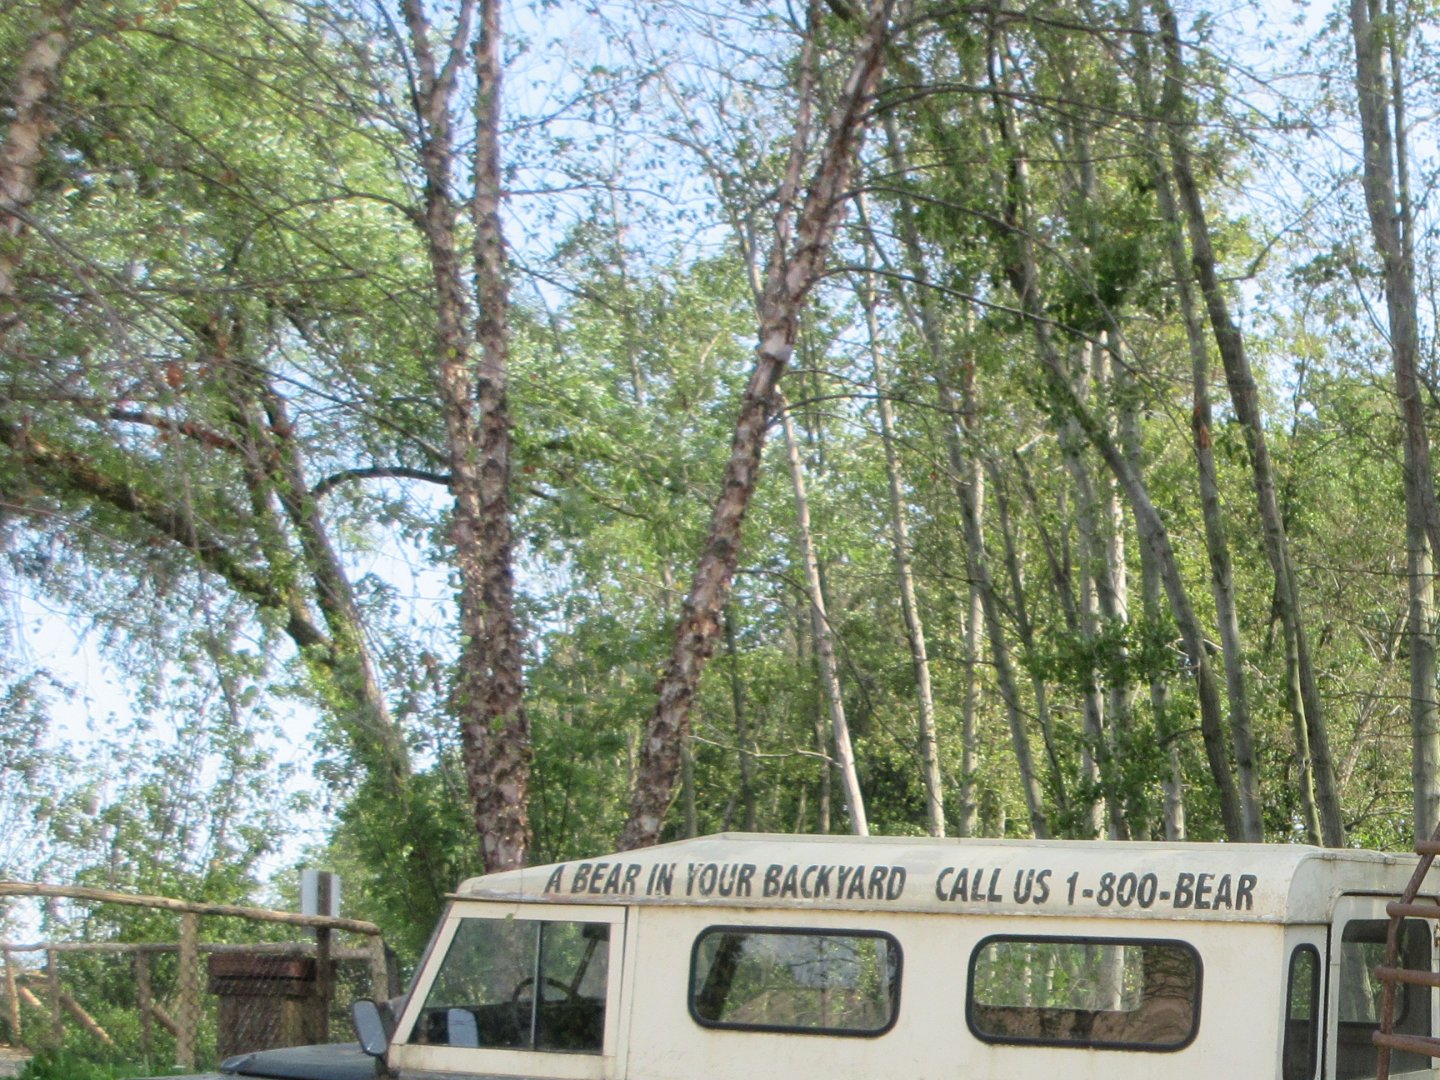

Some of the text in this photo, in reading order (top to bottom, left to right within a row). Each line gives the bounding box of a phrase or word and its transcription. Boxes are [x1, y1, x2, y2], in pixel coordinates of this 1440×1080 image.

[545, 863, 907, 901] A BEAR IN YOUR BACKYARD
[935, 867, 1258, 911] CALL US 1-800-BEAR
